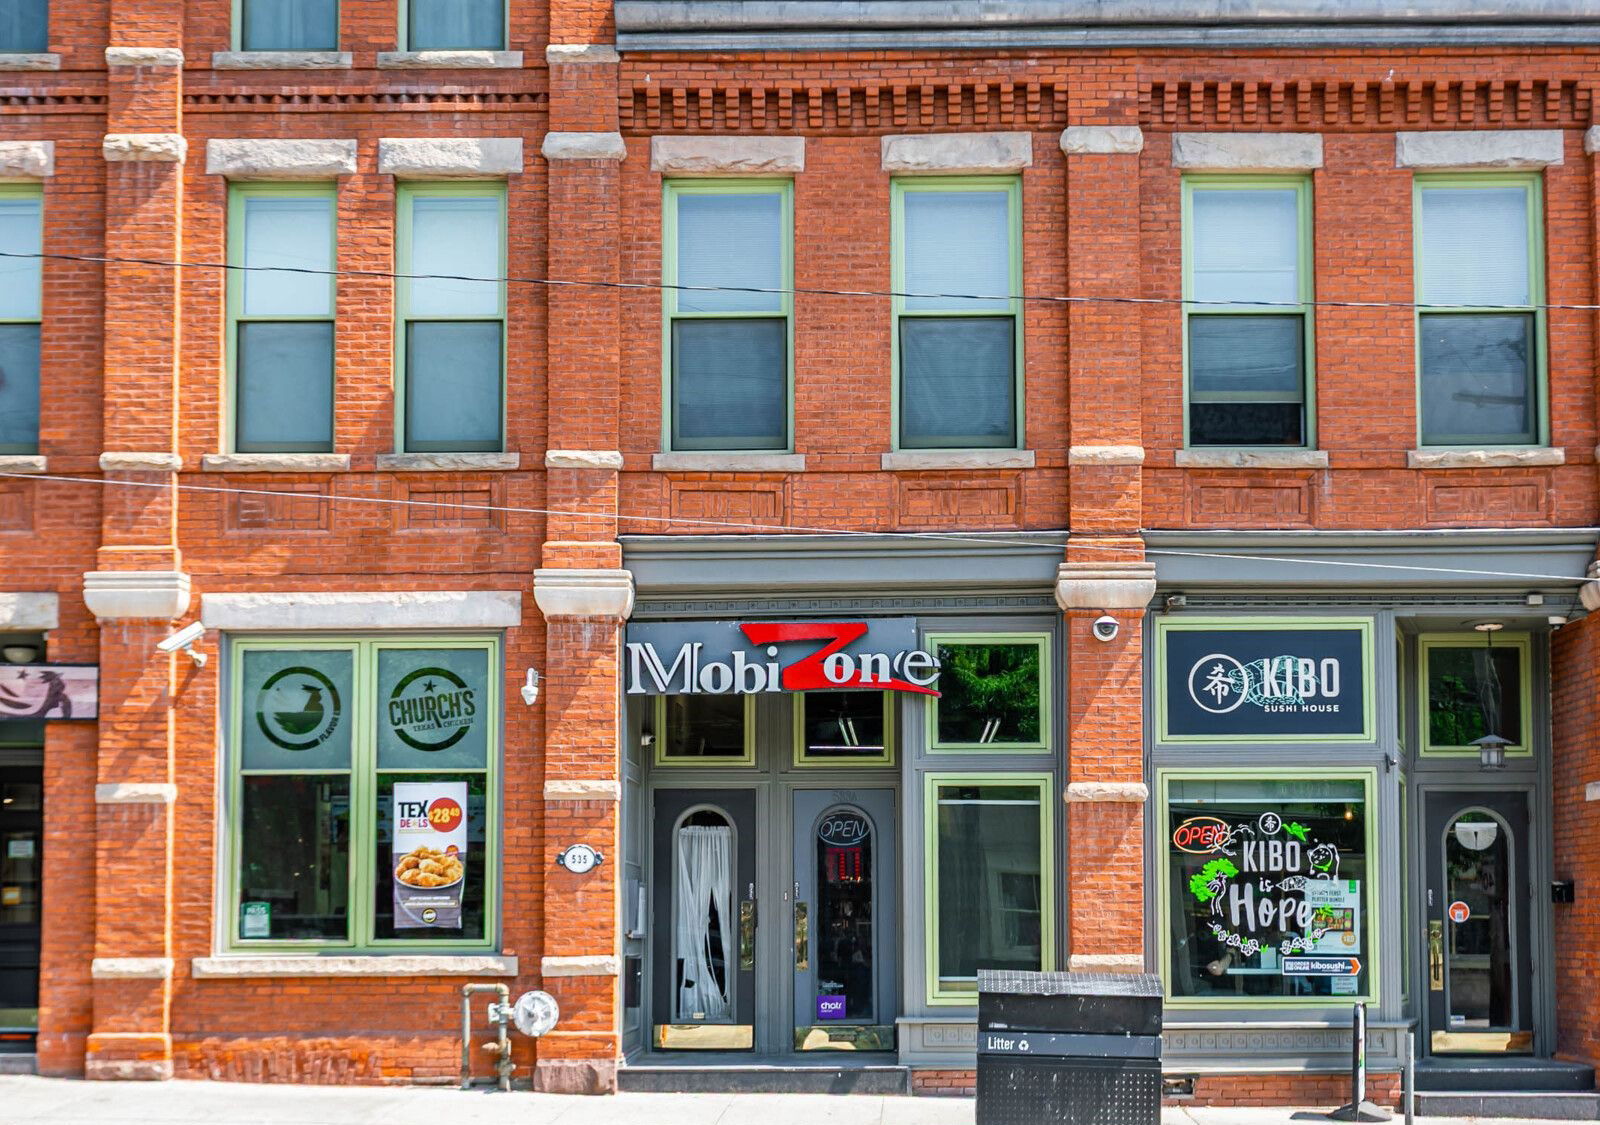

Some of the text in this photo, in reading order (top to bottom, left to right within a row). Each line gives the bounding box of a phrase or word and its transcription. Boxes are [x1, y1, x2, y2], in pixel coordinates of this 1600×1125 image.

[625, 622, 942, 698] MobiZone
[1203, 663, 1235, 705] 希
[1264, 658, 1340, 697] KIBO
[388, 690, 476, 728] CHURCH'S
[1264, 704, 1340, 713] SUSHI HOUSE
[413, 723, 436, 732] TEXAS
[398, 800, 428, 818] TEX
[400, 819, 428, 828] DELS
[821, 820, 866, 838] OPEN
[1175, 824, 1226, 846] OPEN
[572, 854, 588, 864] 535
[1243, 840, 1301, 873] KIBO
[1259, 876, 1275, 893] is
[1229, 882, 1317, 933] Hope
[988, 1036, 1015, 1050] Litter
